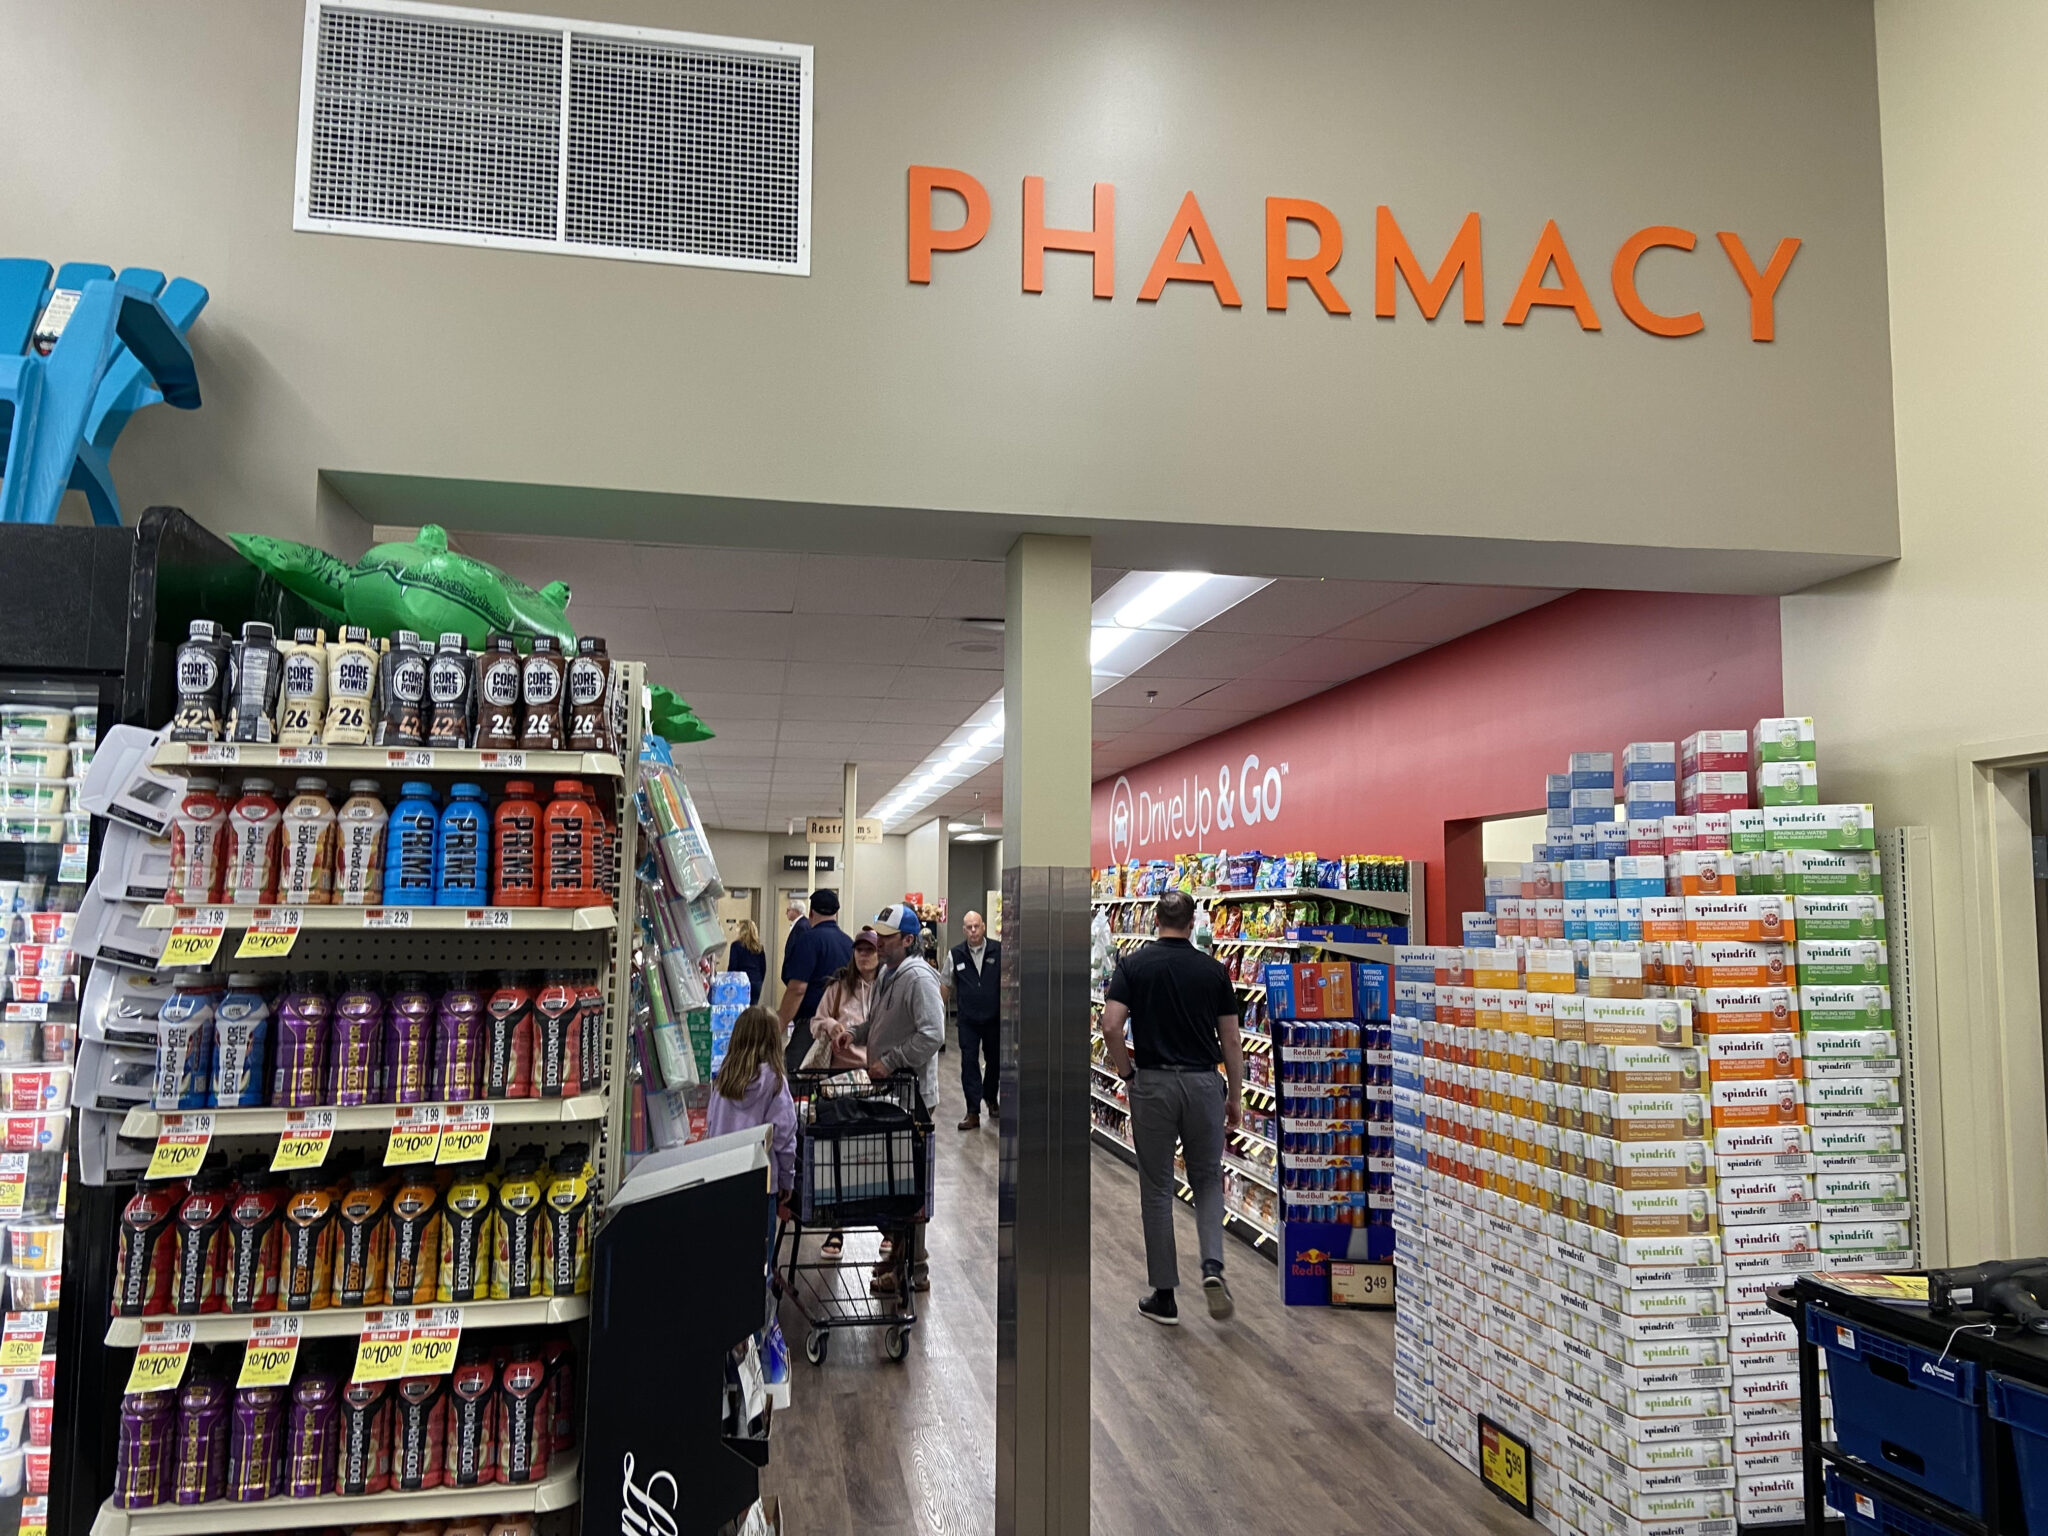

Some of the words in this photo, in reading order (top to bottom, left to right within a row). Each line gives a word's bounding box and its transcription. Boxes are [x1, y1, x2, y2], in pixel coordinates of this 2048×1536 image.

[907, 165, 1802, 344] PHARMACY
[181, 662, 208, 676] CORE
[287, 667, 314, 681] CORE
[340, 664, 369, 679] CORE
[182, 675, 208, 687] POWER
[402, 670, 424, 684] CORE
[433, 672, 458, 684] CORE
[493, 673, 517, 687] CORE
[527, 672, 553, 685] CORE
[572, 672, 596, 685] CORE
[287, 681, 313, 695] POWER
[339, 678, 368, 691] POWER
[401, 683, 424, 695] POWER
[434, 683, 458, 694] POWER
[527, 685, 552, 696] POWER
[573, 686, 596, 697] POWER
[492, 686, 517, 699] POWER
[1216, 765, 1235, 831] &
[1773, 813, 1826, 826] spindrift
[811, 823, 871, 833] Restrms
[293, 825, 309, 892] BODYARMOR
[349, 826, 365, 892] BODYARMOR
[401, 816, 435, 890] PRIME
[444, 817, 477, 890] PRIME
[502, 816, 535, 890] PRIME
[551, 816, 583, 890] PRIME
[790, 859, 828, 867] Consution
[1802, 858, 1846, 870] spindrift
[1695, 903, 1747, 916] spindrift
[1804, 903, 1848, 914] spindrift
[1711, 949, 1756, 962] spindrift
[1807, 948, 1851, 959] spindrift
[1716, 995, 1761, 1008] spindrift
[1810, 993, 1854, 1005] spindrift
[1593, 1006, 1645, 1018] spindrift
[1718, 1042, 1764, 1054] spindrift
[1817, 1039, 1861, 1051] spindrift
[492, 1019, 506, 1087] BODYARMOR
[546, 1019, 560, 1087] BODYARMOR
[1625, 1053, 1670, 1067] spindrift
[223, 1026, 240, 1095] BODYARMOR
[1819, 1087, 1863, 1099] spindrift
[1630, 1150, 1676, 1162] spindrift
[1822, 1158, 1856, 1167] spindrift
[1731, 1184, 1776, 1198] spindrift
[1825, 1182, 1871, 1194] spindrift
[348, 1223, 362, 1290] BODYARMOR
[398, 1221, 413, 1287] BODYARMOR
[458, 1218, 473, 1291] BODYARMOR
[514, 1214, 527, 1287] BODYARMOR
[558, 1214, 570, 1285] BODYARMOR
[1558, 1245, 1585, 1262] spindrift
[1636, 1247, 1683, 1261] spindrift
[127, 1231, 145, 1305] BODYARMOR
[183, 1229, 201, 1303] BODYARMOR
[237, 1228, 253, 1303] BODYARMOR
[294, 1228, 310, 1294] BODYARMOR
[1291, 1265, 1313, 1275] Red
[1315, 1265, 1326, 1275] Bu
[1636, 1273, 1671, 1284] spindrift
[1741, 1332, 1786, 1346] spindrift
[1643, 1347, 1690, 1360] spindrift
[1740, 1356, 1775, 1367] spindrift
[406, 1405, 421, 1479] BODYARMOR
[462, 1401, 476, 1474] BODYARMOR
[514, 1398, 526, 1472] BODYARMOR
[1745, 1432, 1790, 1446] spindrift
[350, 1410, 364, 1483] BODYARMOR
[1646, 1449, 1693, 1462] spindrift
